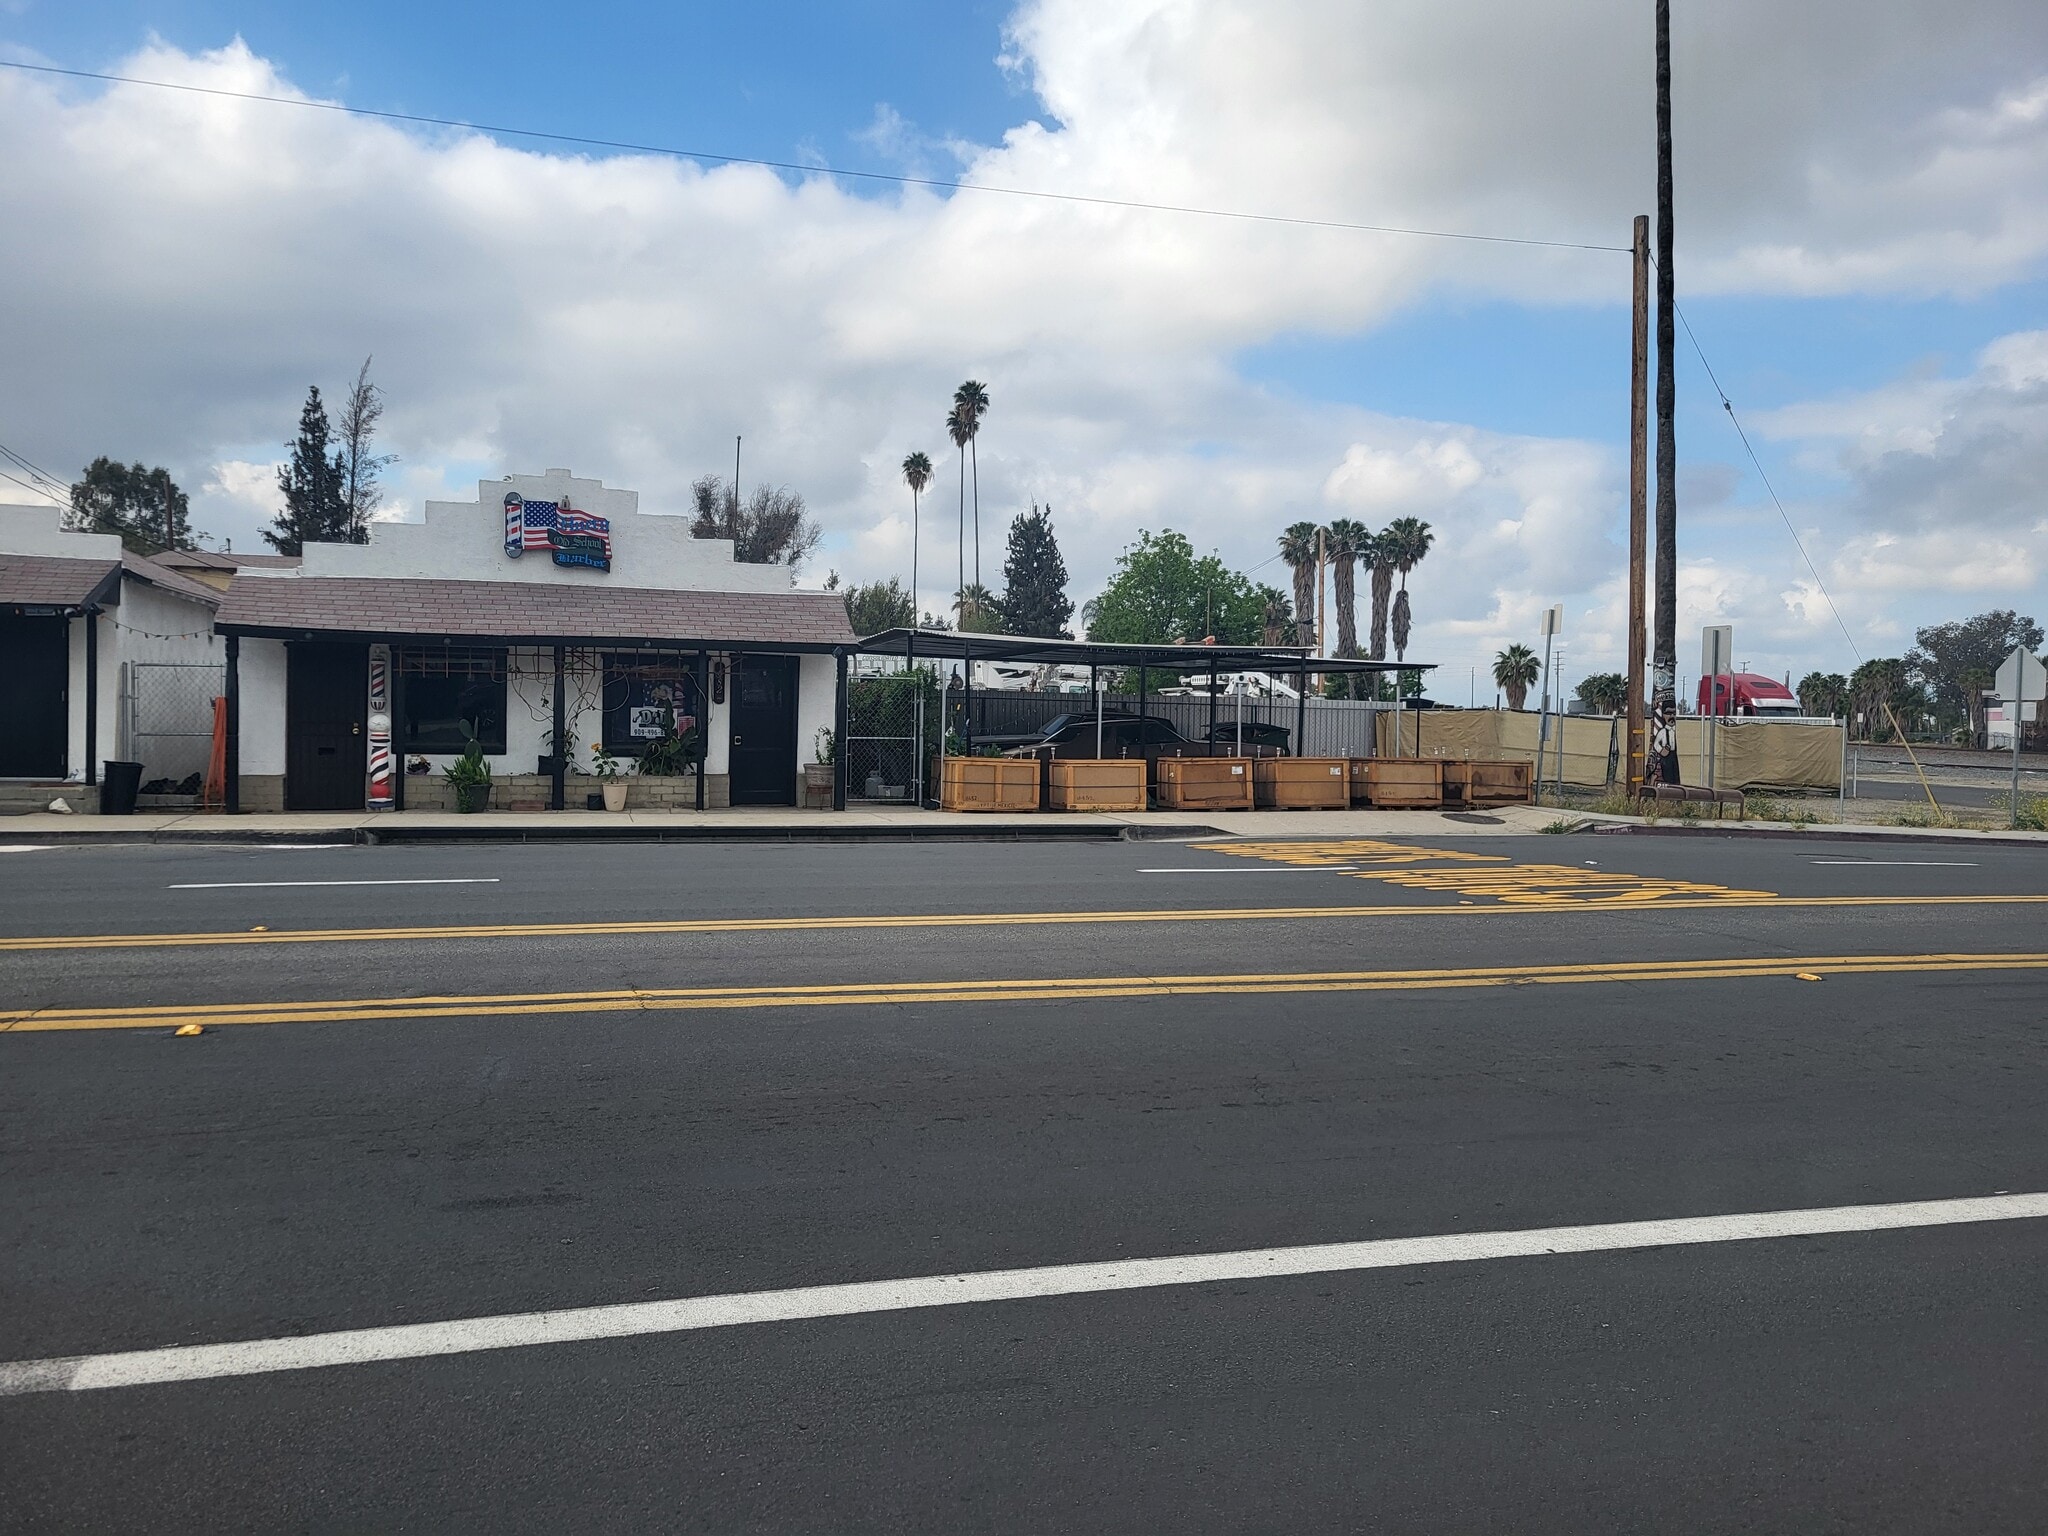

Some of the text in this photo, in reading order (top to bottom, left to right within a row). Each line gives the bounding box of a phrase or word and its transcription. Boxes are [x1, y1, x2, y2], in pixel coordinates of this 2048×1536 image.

[553, 536, 602, 550] Old School
[556, 553, 606, 567] Barber
